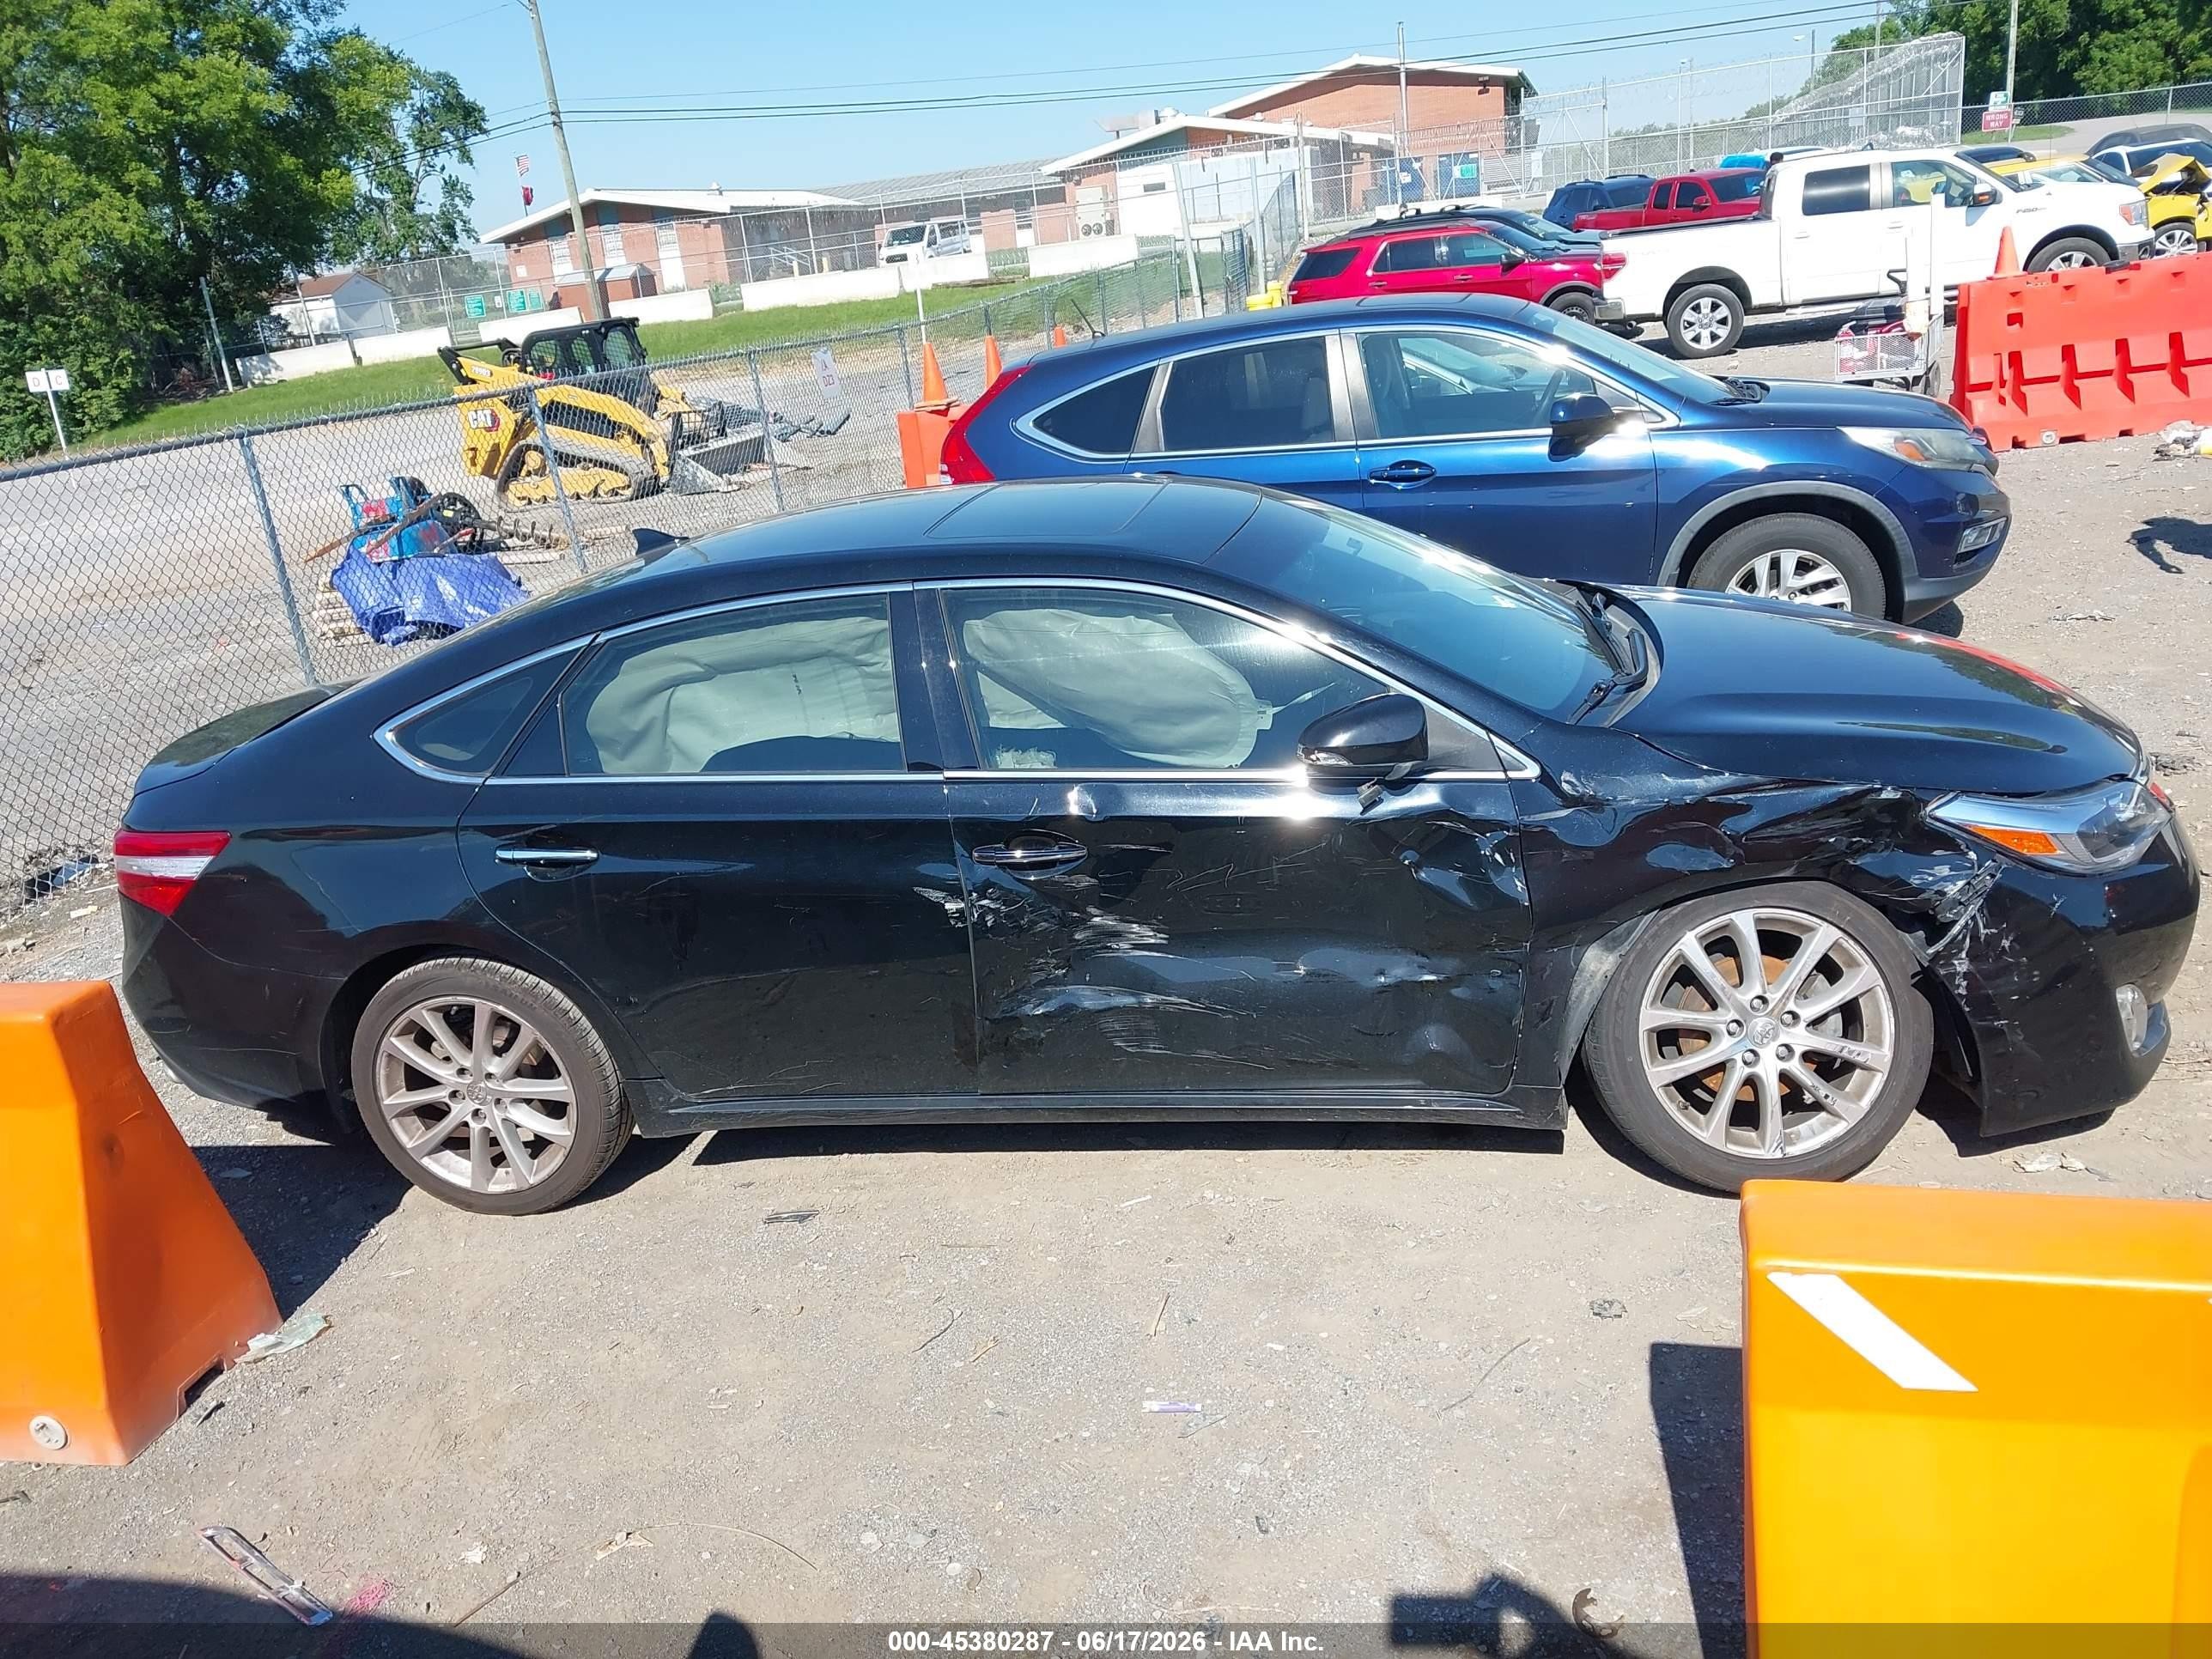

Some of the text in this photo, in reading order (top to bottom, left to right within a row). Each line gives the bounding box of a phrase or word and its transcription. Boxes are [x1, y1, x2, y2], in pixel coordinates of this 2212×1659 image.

[33, 375, 63, 387] D C
[468, 410, 492, 428] CAT
